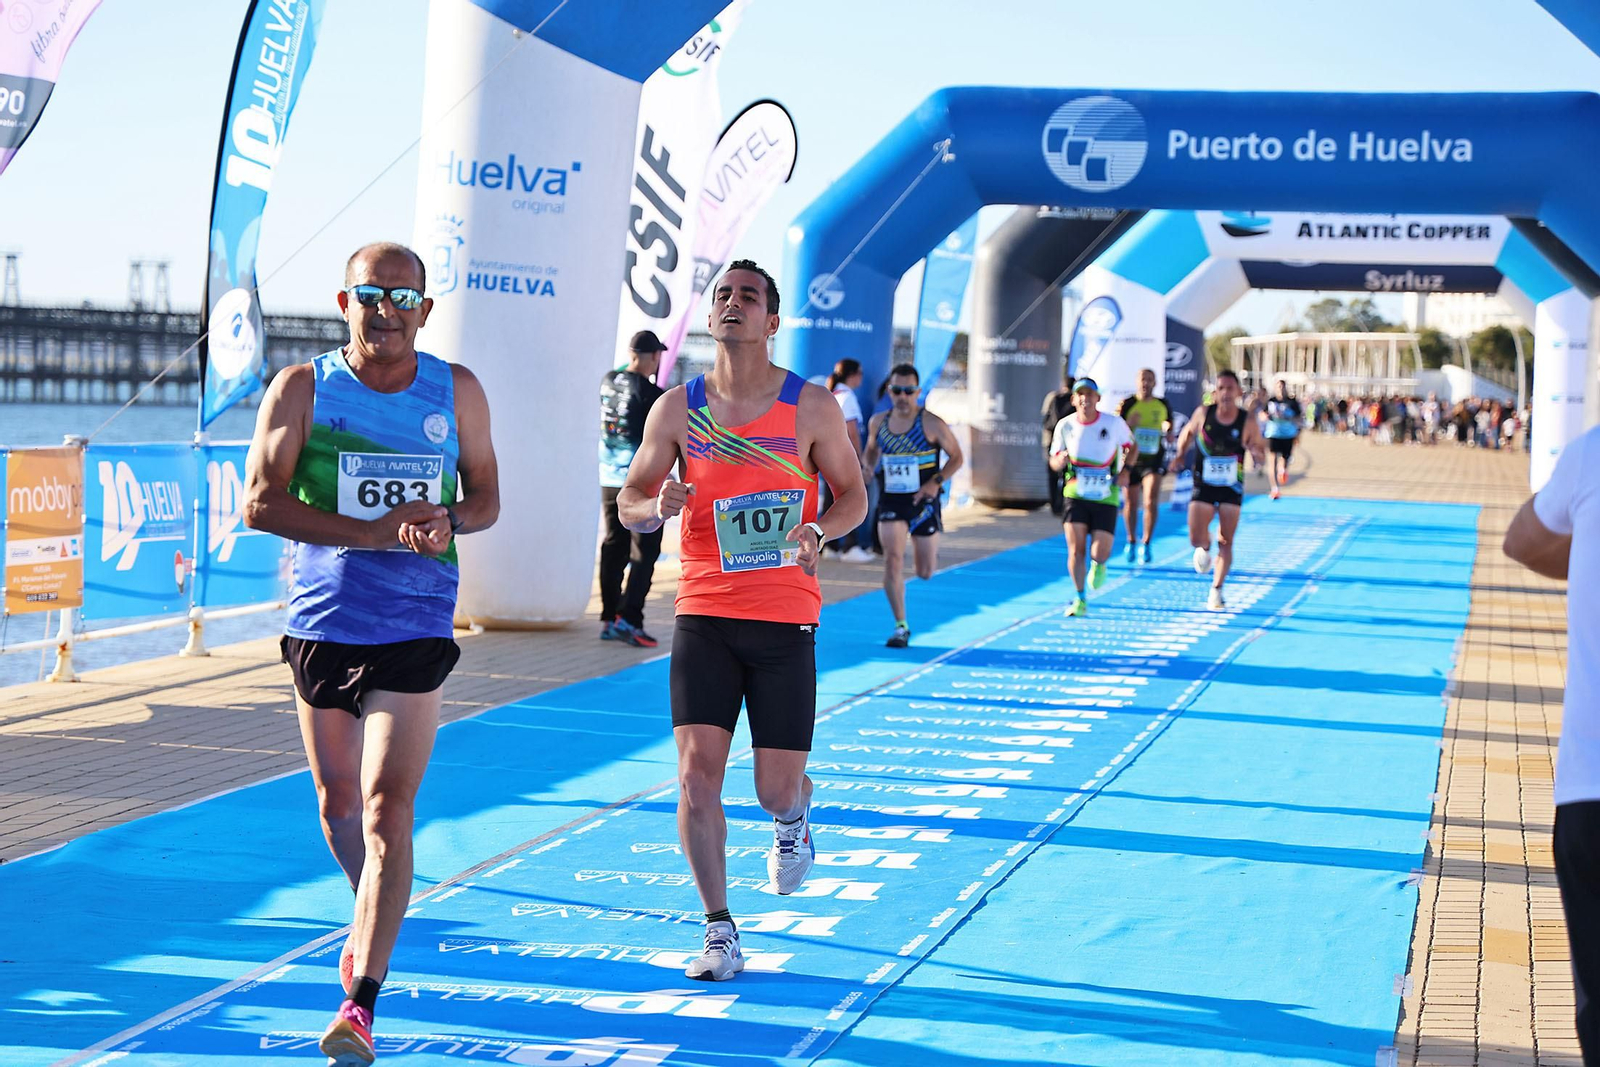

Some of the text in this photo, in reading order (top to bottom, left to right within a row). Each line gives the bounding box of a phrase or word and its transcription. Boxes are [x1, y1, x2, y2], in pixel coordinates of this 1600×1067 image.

[250, 0, 298, 118] HUELVA
[686, 35, 721, 63] SIF
[1167, 130, 1473, 163] Puerto de Huelva
[436, 150, 567, 197] Huelva
[512, 197, 564, 214] original
[622, 124, 687, 319] CSIF
[1297, 221, 1491, 240] ATLANTIC COPPER
[468, 257, 559, 276] Ayuntamiento de
[466, 273, 555, 297] HUELVA
[345, 456, 363, 476] 10
[361, 460, 386, 470] HUELVA
[357, 479, 430, 509] 683
[718, 498, 733, 511] 10
[98, 461, 185, 571] 10 HUELVA
[207, 461, 244, 563] 10
[732, 507, 790, 535] 107
[734, 551, 777, 565] Wayalia
[438, 942, 660, 963] HUELVA
[580, 989, 739, 1018] 10
